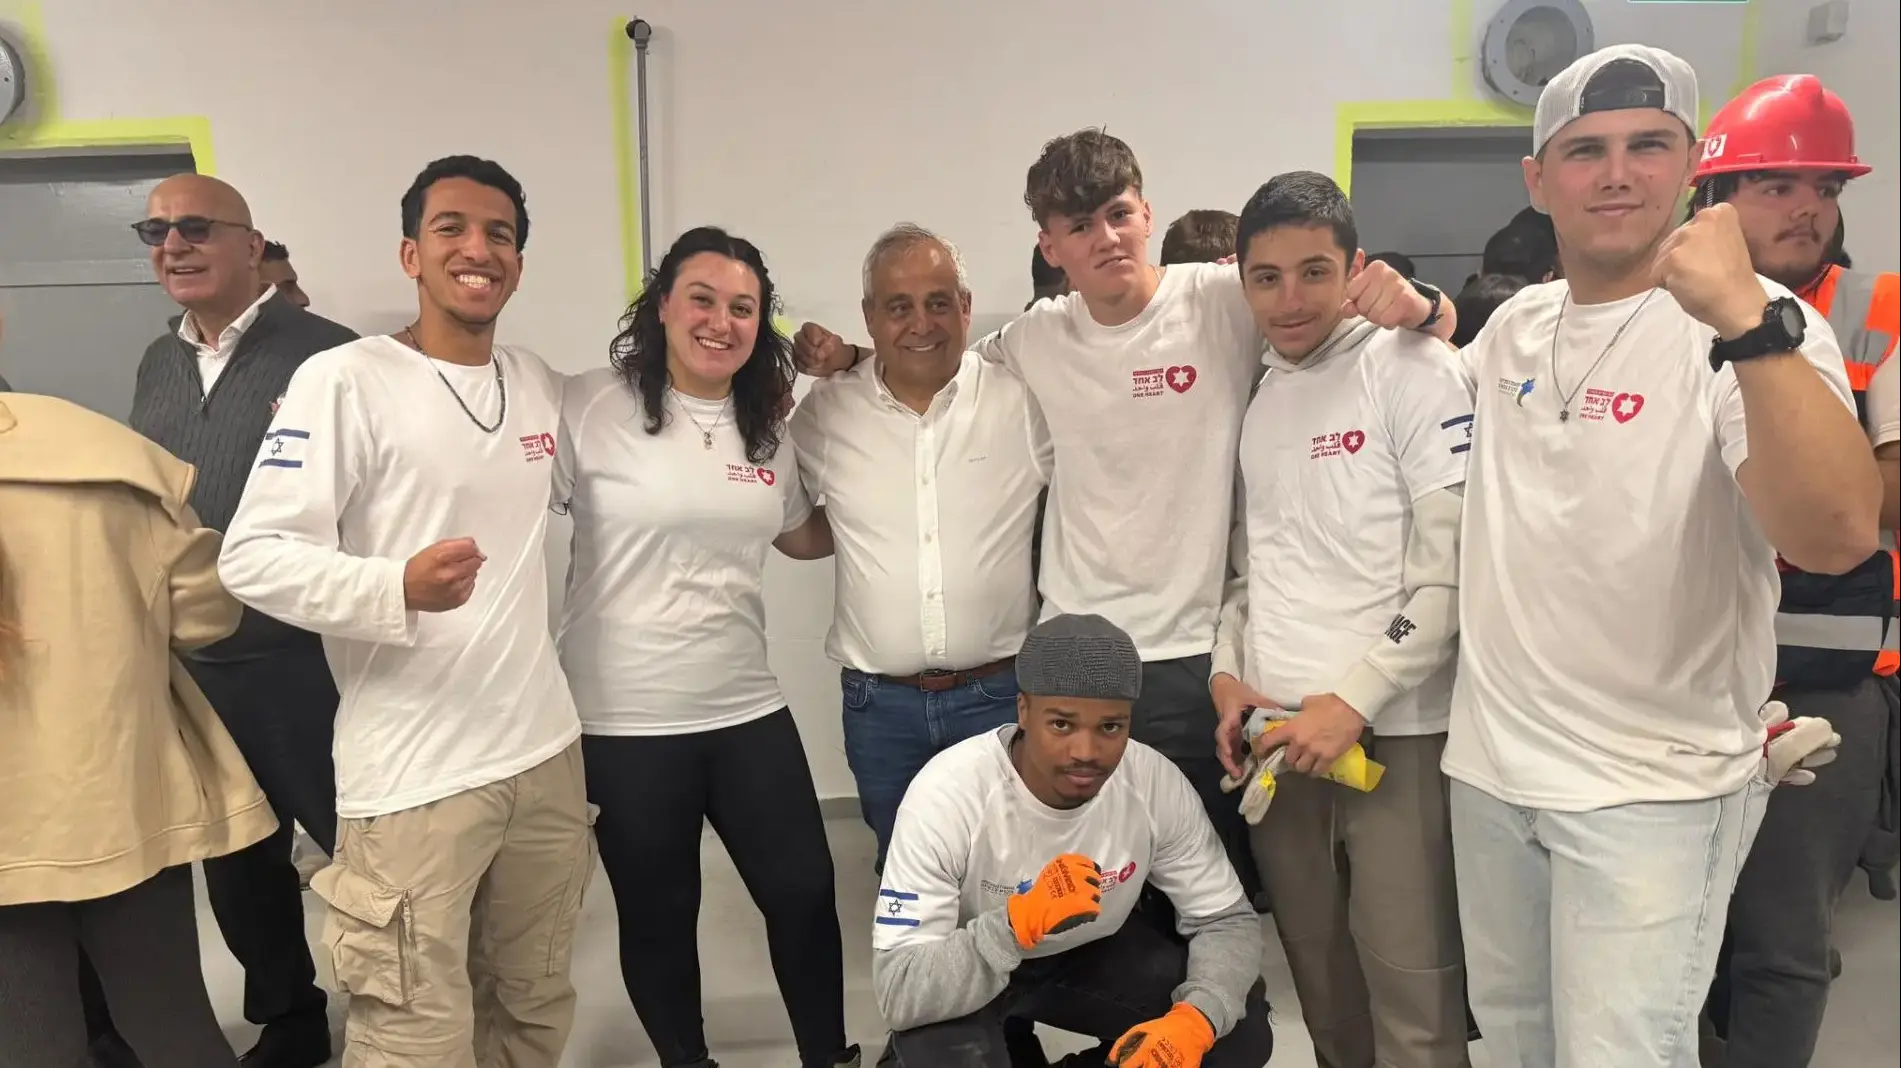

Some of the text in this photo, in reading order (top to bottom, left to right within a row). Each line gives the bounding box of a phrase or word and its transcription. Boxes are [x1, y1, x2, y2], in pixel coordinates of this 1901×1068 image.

[1132, 374, 1164, 385] לב אחד
[1585, 396, 1600, 405] אחד
[1312, 432, 1341, 445] לב אחד
[1321, 450, 1341, 458] HEART
